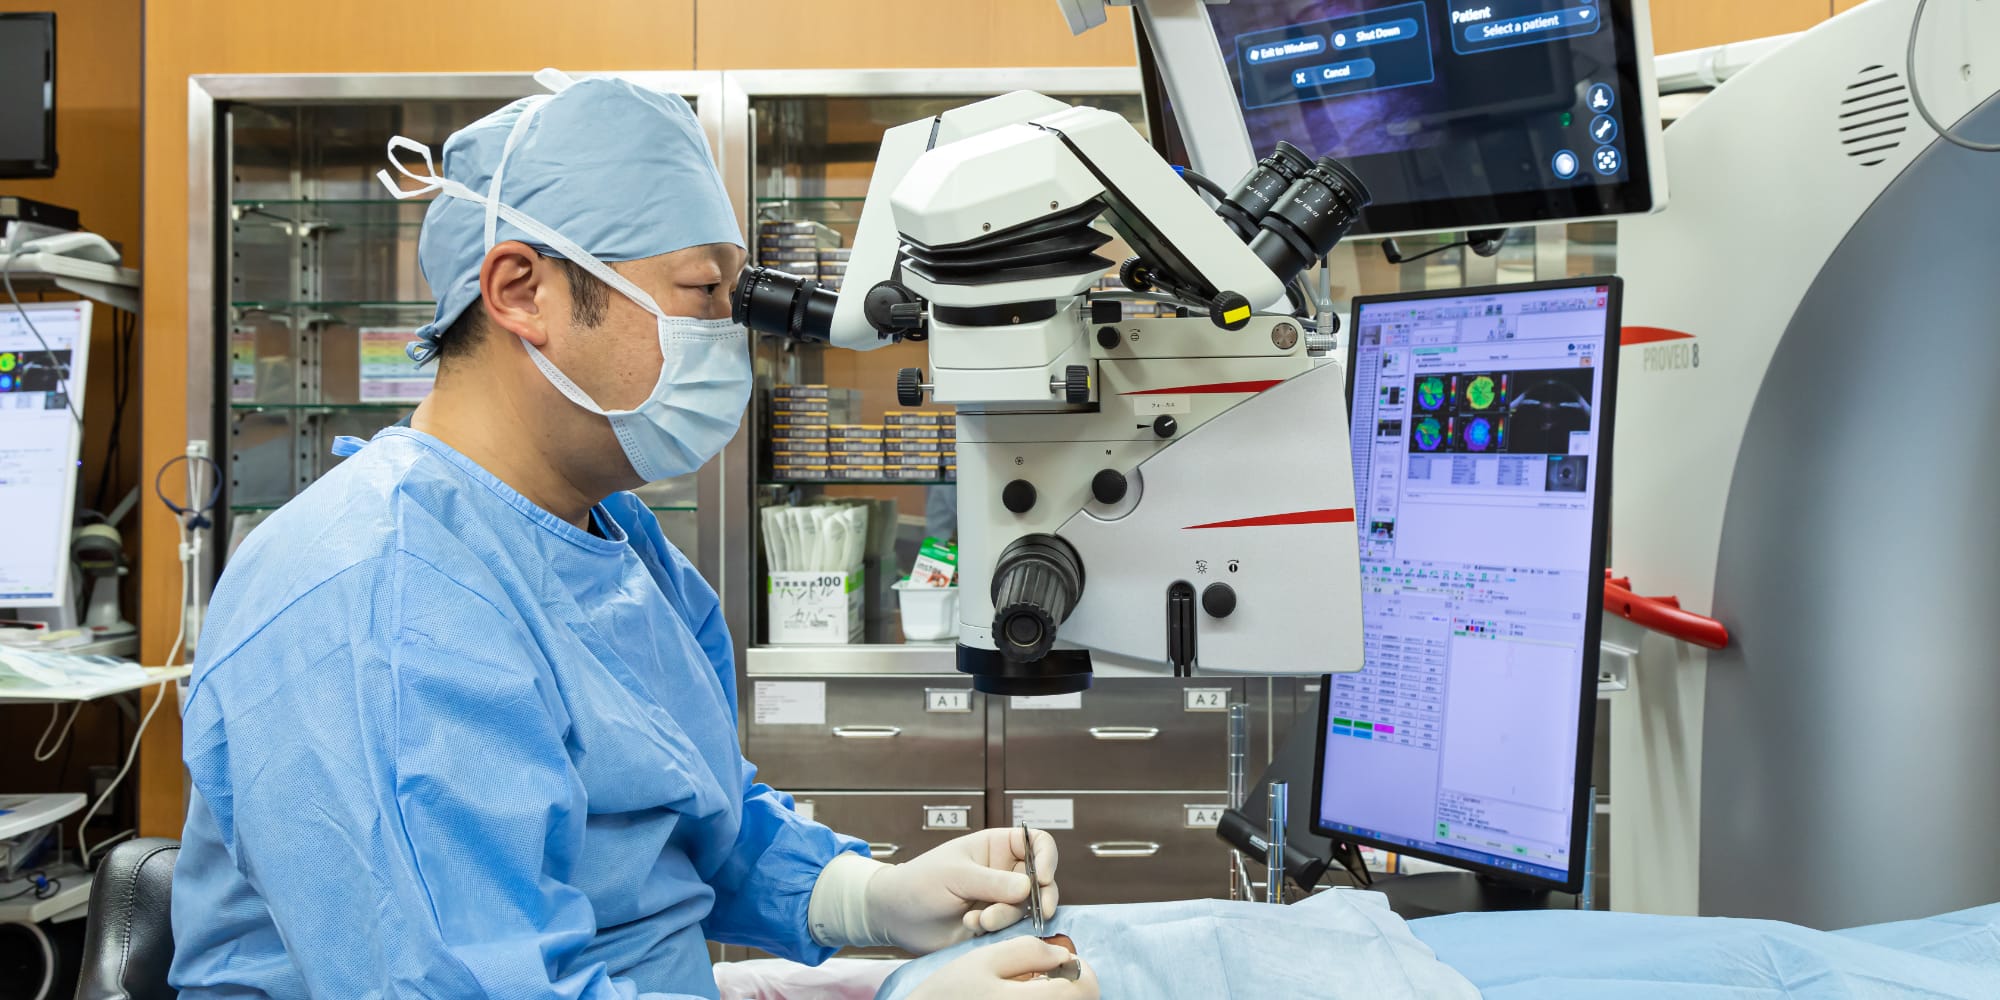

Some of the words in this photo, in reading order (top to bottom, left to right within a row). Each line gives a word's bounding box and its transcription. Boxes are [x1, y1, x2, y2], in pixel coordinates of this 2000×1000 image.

[1452, 6, 1491, 24] Patient
[1483, 22, 1513, 38] Select
[1514, 23, 1522, 32] a
[1522, 15, 1559, 33] patient
[1355, 29, 1375, 43] Shut
[1375, 26, 1401, 39] Down
[1260, 48, 1275, 59] Exit
[1275, 45, 1284, 56] to
[1284, 40, 1319, 55] Windows
[1323, 65, 1350, 79] Cancel
[1643, 343, 1689, 372] PROVEO
[1692, 342, 1700, 369] 8
[817, 576, 842, 588] 100
[937, 695, 948, 706] A
[1195, 694, 1206, 705] A
[1210, 693, 1218, 706] 2
[936, 812, 946, 824] A
[950, 812, 959, 825] 3
[1195, 811, 1206, 822] A
[1210, 811, 1218, 821] 4
